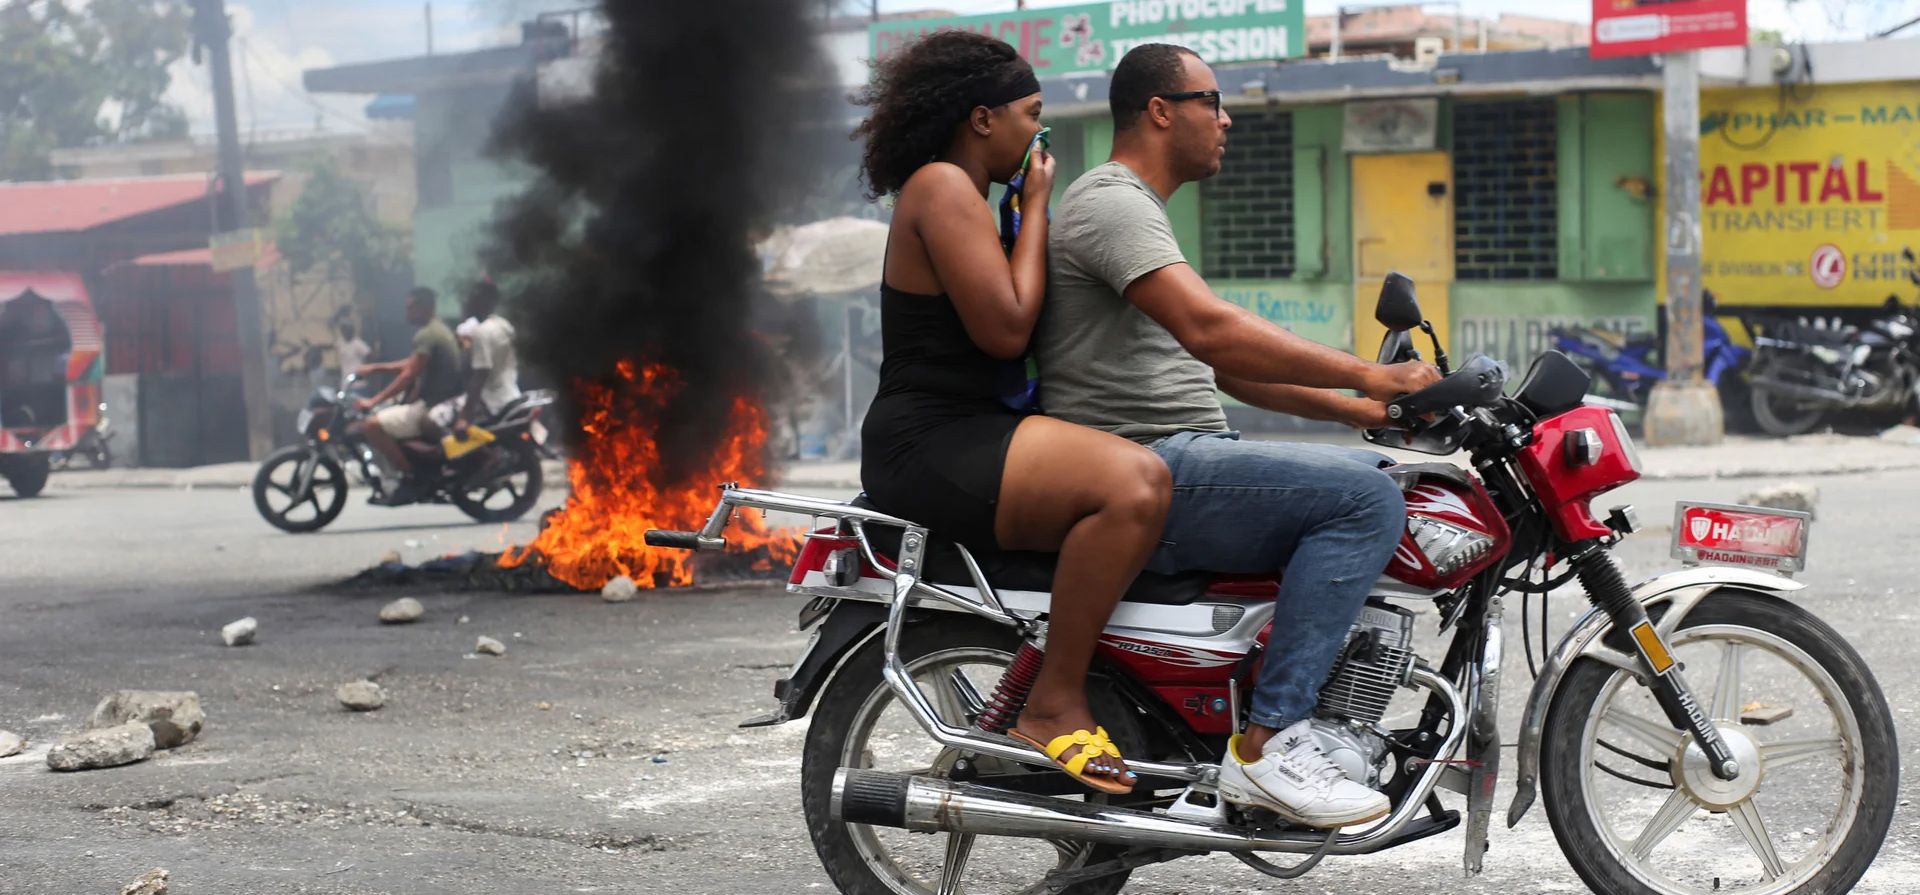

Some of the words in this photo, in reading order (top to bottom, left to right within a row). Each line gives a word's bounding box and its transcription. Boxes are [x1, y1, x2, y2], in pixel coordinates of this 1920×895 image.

[1110, 26, 1288, 70] IESSION
[1699, 160, 1883, 206] APITAL
[1709, 208, 1881, 232] TRANSFERT
